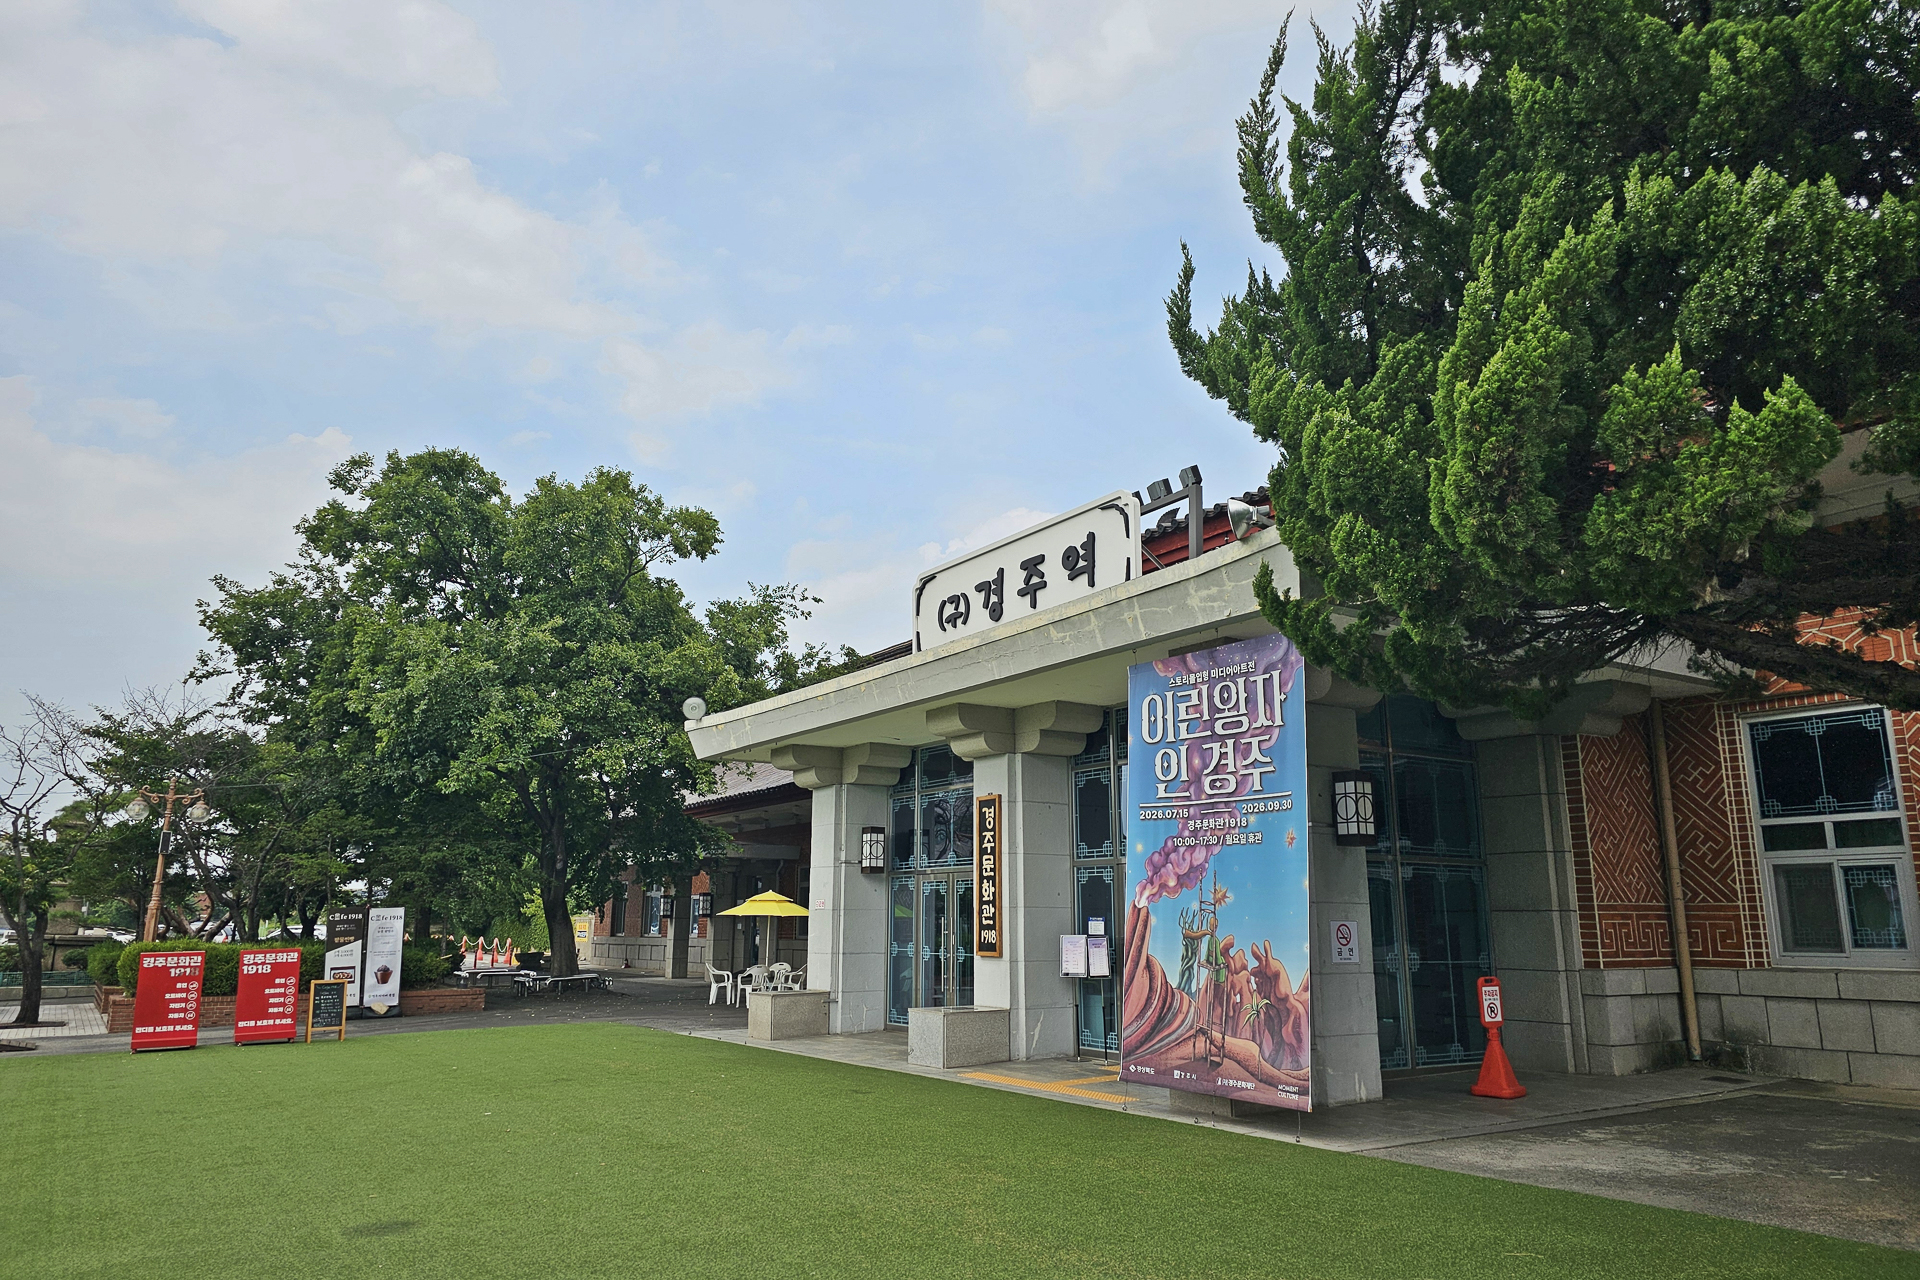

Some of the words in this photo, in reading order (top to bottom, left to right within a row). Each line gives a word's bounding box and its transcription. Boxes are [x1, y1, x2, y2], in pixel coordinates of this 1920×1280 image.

[974, 531, 1096, 622] 경주역
[1169, 670, 1209, 687] 스토리몰입형
[1211, 661, 1255, 678] 미디어아트전
[1141, 669, 1286, 744] 어린왕자
[1154, 745, 1190, 799] 인
[1203, 735, 1276, 795] 경주
[1140, 809, 1188, 819] 2026.07.15
[1242, 800, 1292, 813] 2026.09.30
[1225, 833, 1246, 844] 월요일
[1248, 832, 1262, 843] 휴관
[982, 806, 995, 925] 경주문화관
[981, 929, 996, 944] 1918
[143, 956, 202, 968] 경주문화관
[243, 952, 298, 963] 경주문화관
[242, 964, 271, 974] 1918
[1137, 1066, 1154, 1074] 경상북도
[1278, 1084, 1298, 1093] MOMENT
[1278, 1091, 1298, 1100] CULTURE
